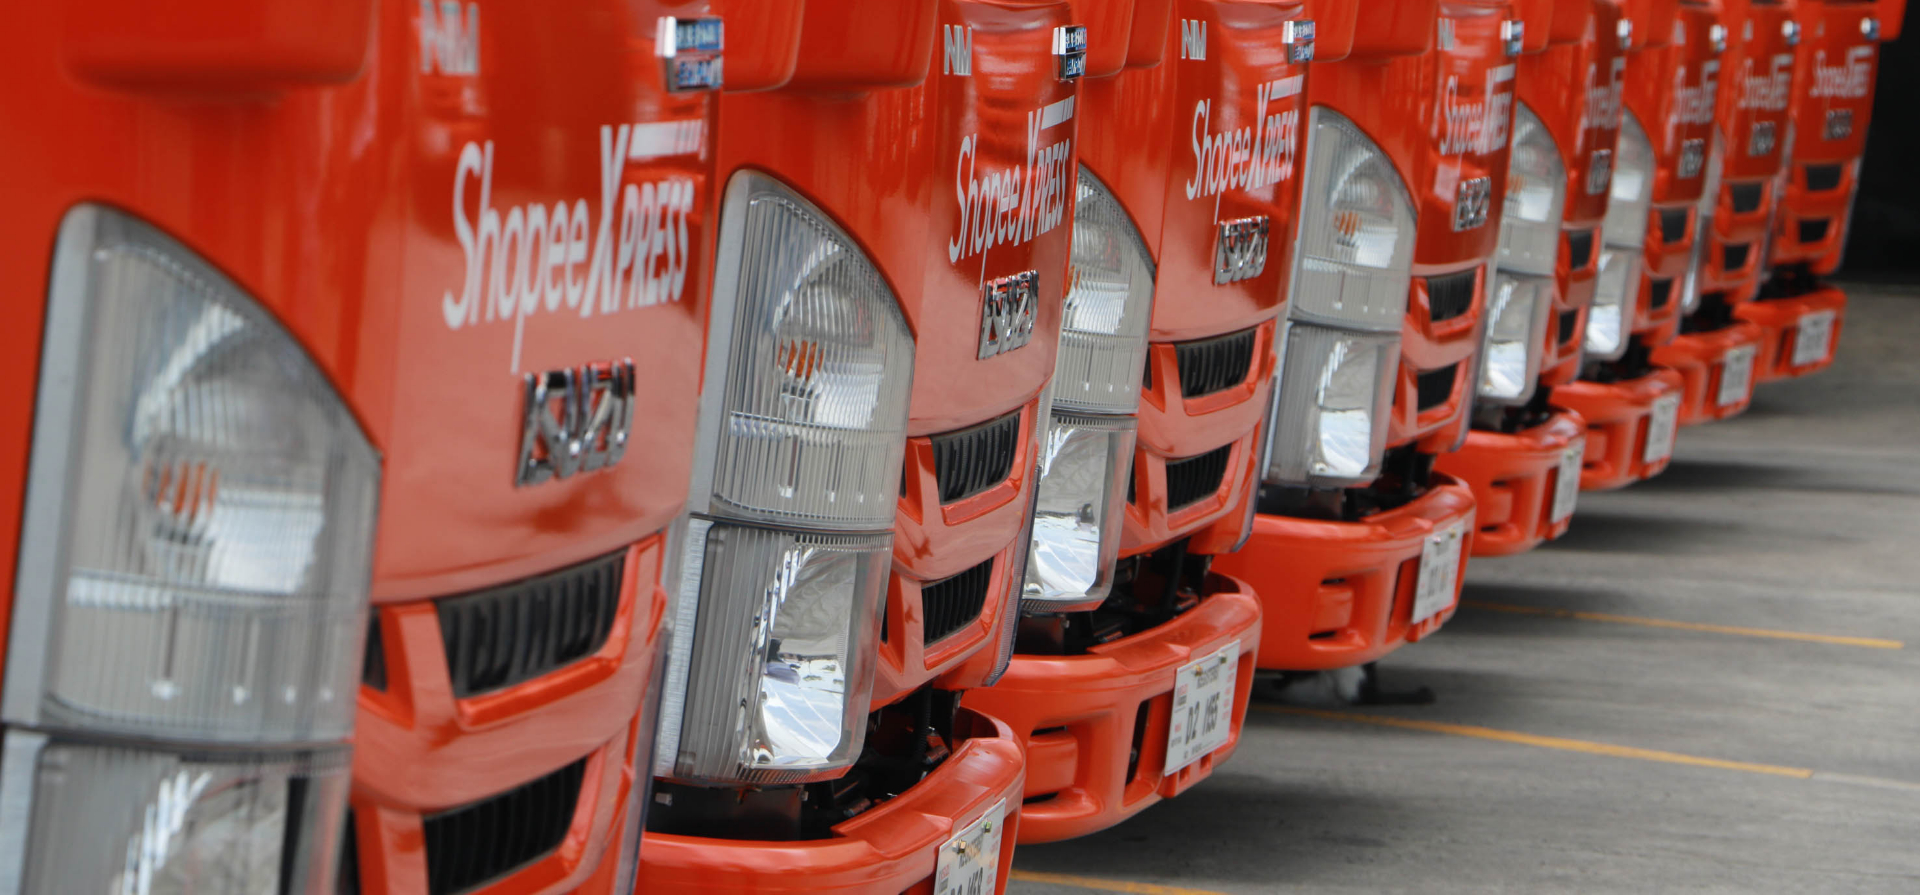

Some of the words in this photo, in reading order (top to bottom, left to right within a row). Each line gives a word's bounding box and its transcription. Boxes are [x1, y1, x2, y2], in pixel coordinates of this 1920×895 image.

[944, 24, 972, 75] NM
[1181, 19, 1206, 60] NM
[949, 133, 1020, 290] Shopee
[1014, 108, 1070, 247] XPRESS
[1186, 98, 1251, 225] Shopee
[442, 139, 589, 375] Shopee
[579, 124, 694, 319] XPRESS
